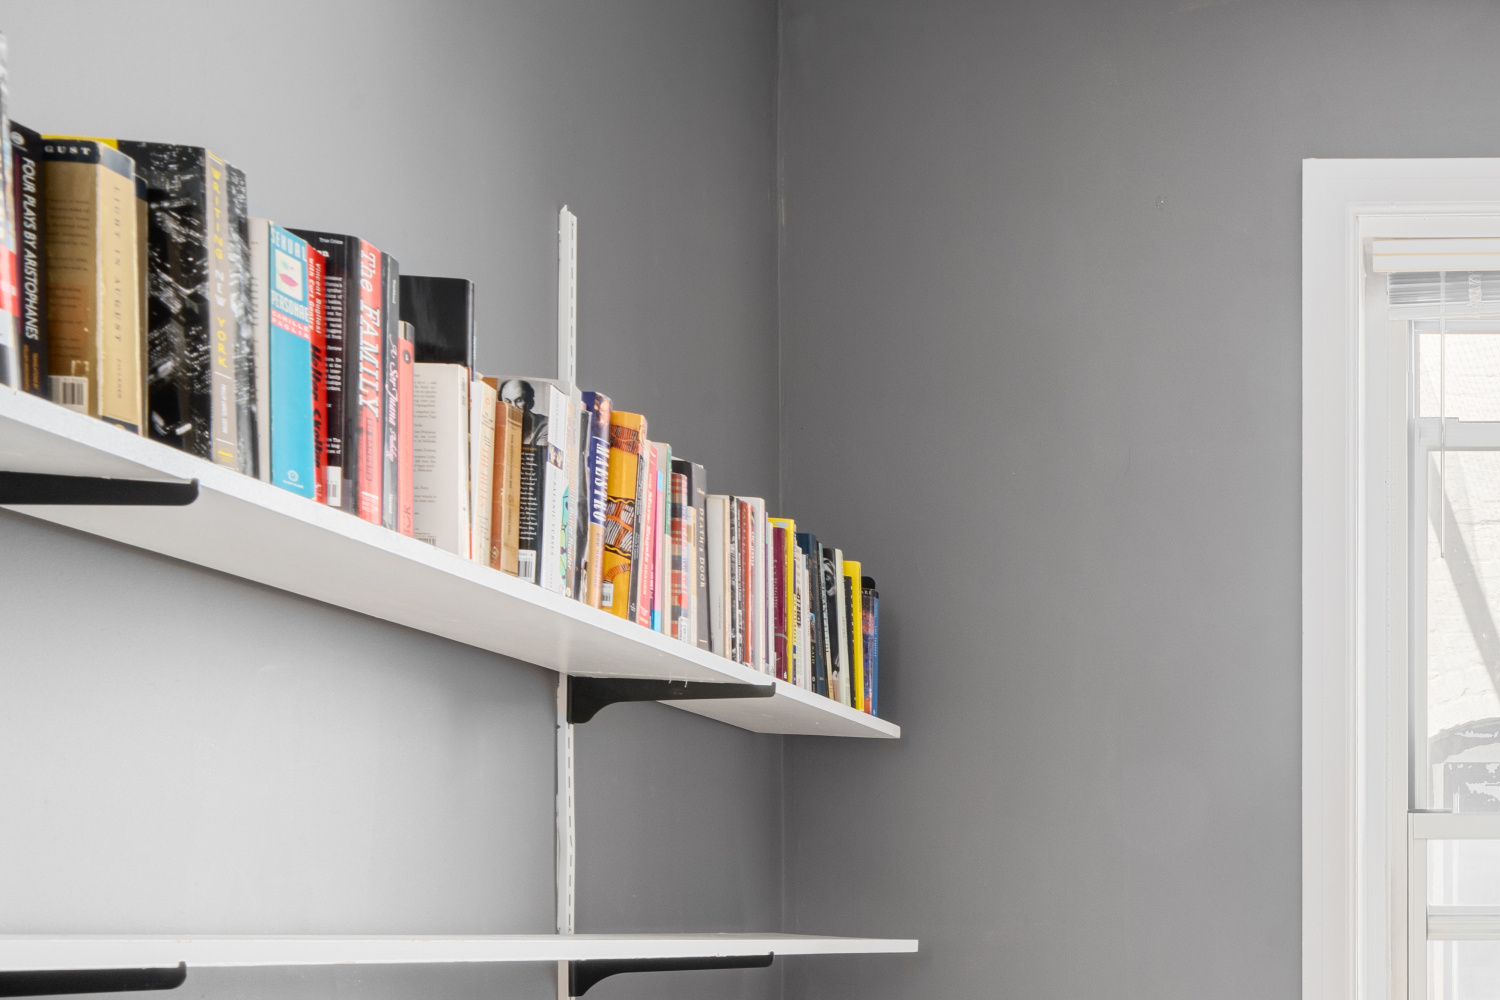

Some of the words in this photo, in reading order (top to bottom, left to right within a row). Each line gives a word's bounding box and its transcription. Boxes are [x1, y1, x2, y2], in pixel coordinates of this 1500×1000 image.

[22, 156, 36, 193] FOUR
[23, 194, 37, 231] PLAYS
[210, 167, 223, 260] WRITING
[24, 230, 37, 250] BY
[214, 269, 226, 307] NEW
[360, 250, 375, 292] The
[24, 249, 39, 341] ARISTOPHANES
[271, 309, 309, 332] CAMILLE
[272, 317, 310, 341] PAGLIA
[217, 317, 228, 369] YORK
[359, 299, 380, 418] FAMILY
[310, 344, 323, 401] Helter
[389, 361, 398, 387] Sor
[312, 409, 323, 468] Skelter
[592, 443, 610, 523] MAESTRO
[644, 491, 652, 562] Marx-Engels
[566, 538, 575, 570] Reader
